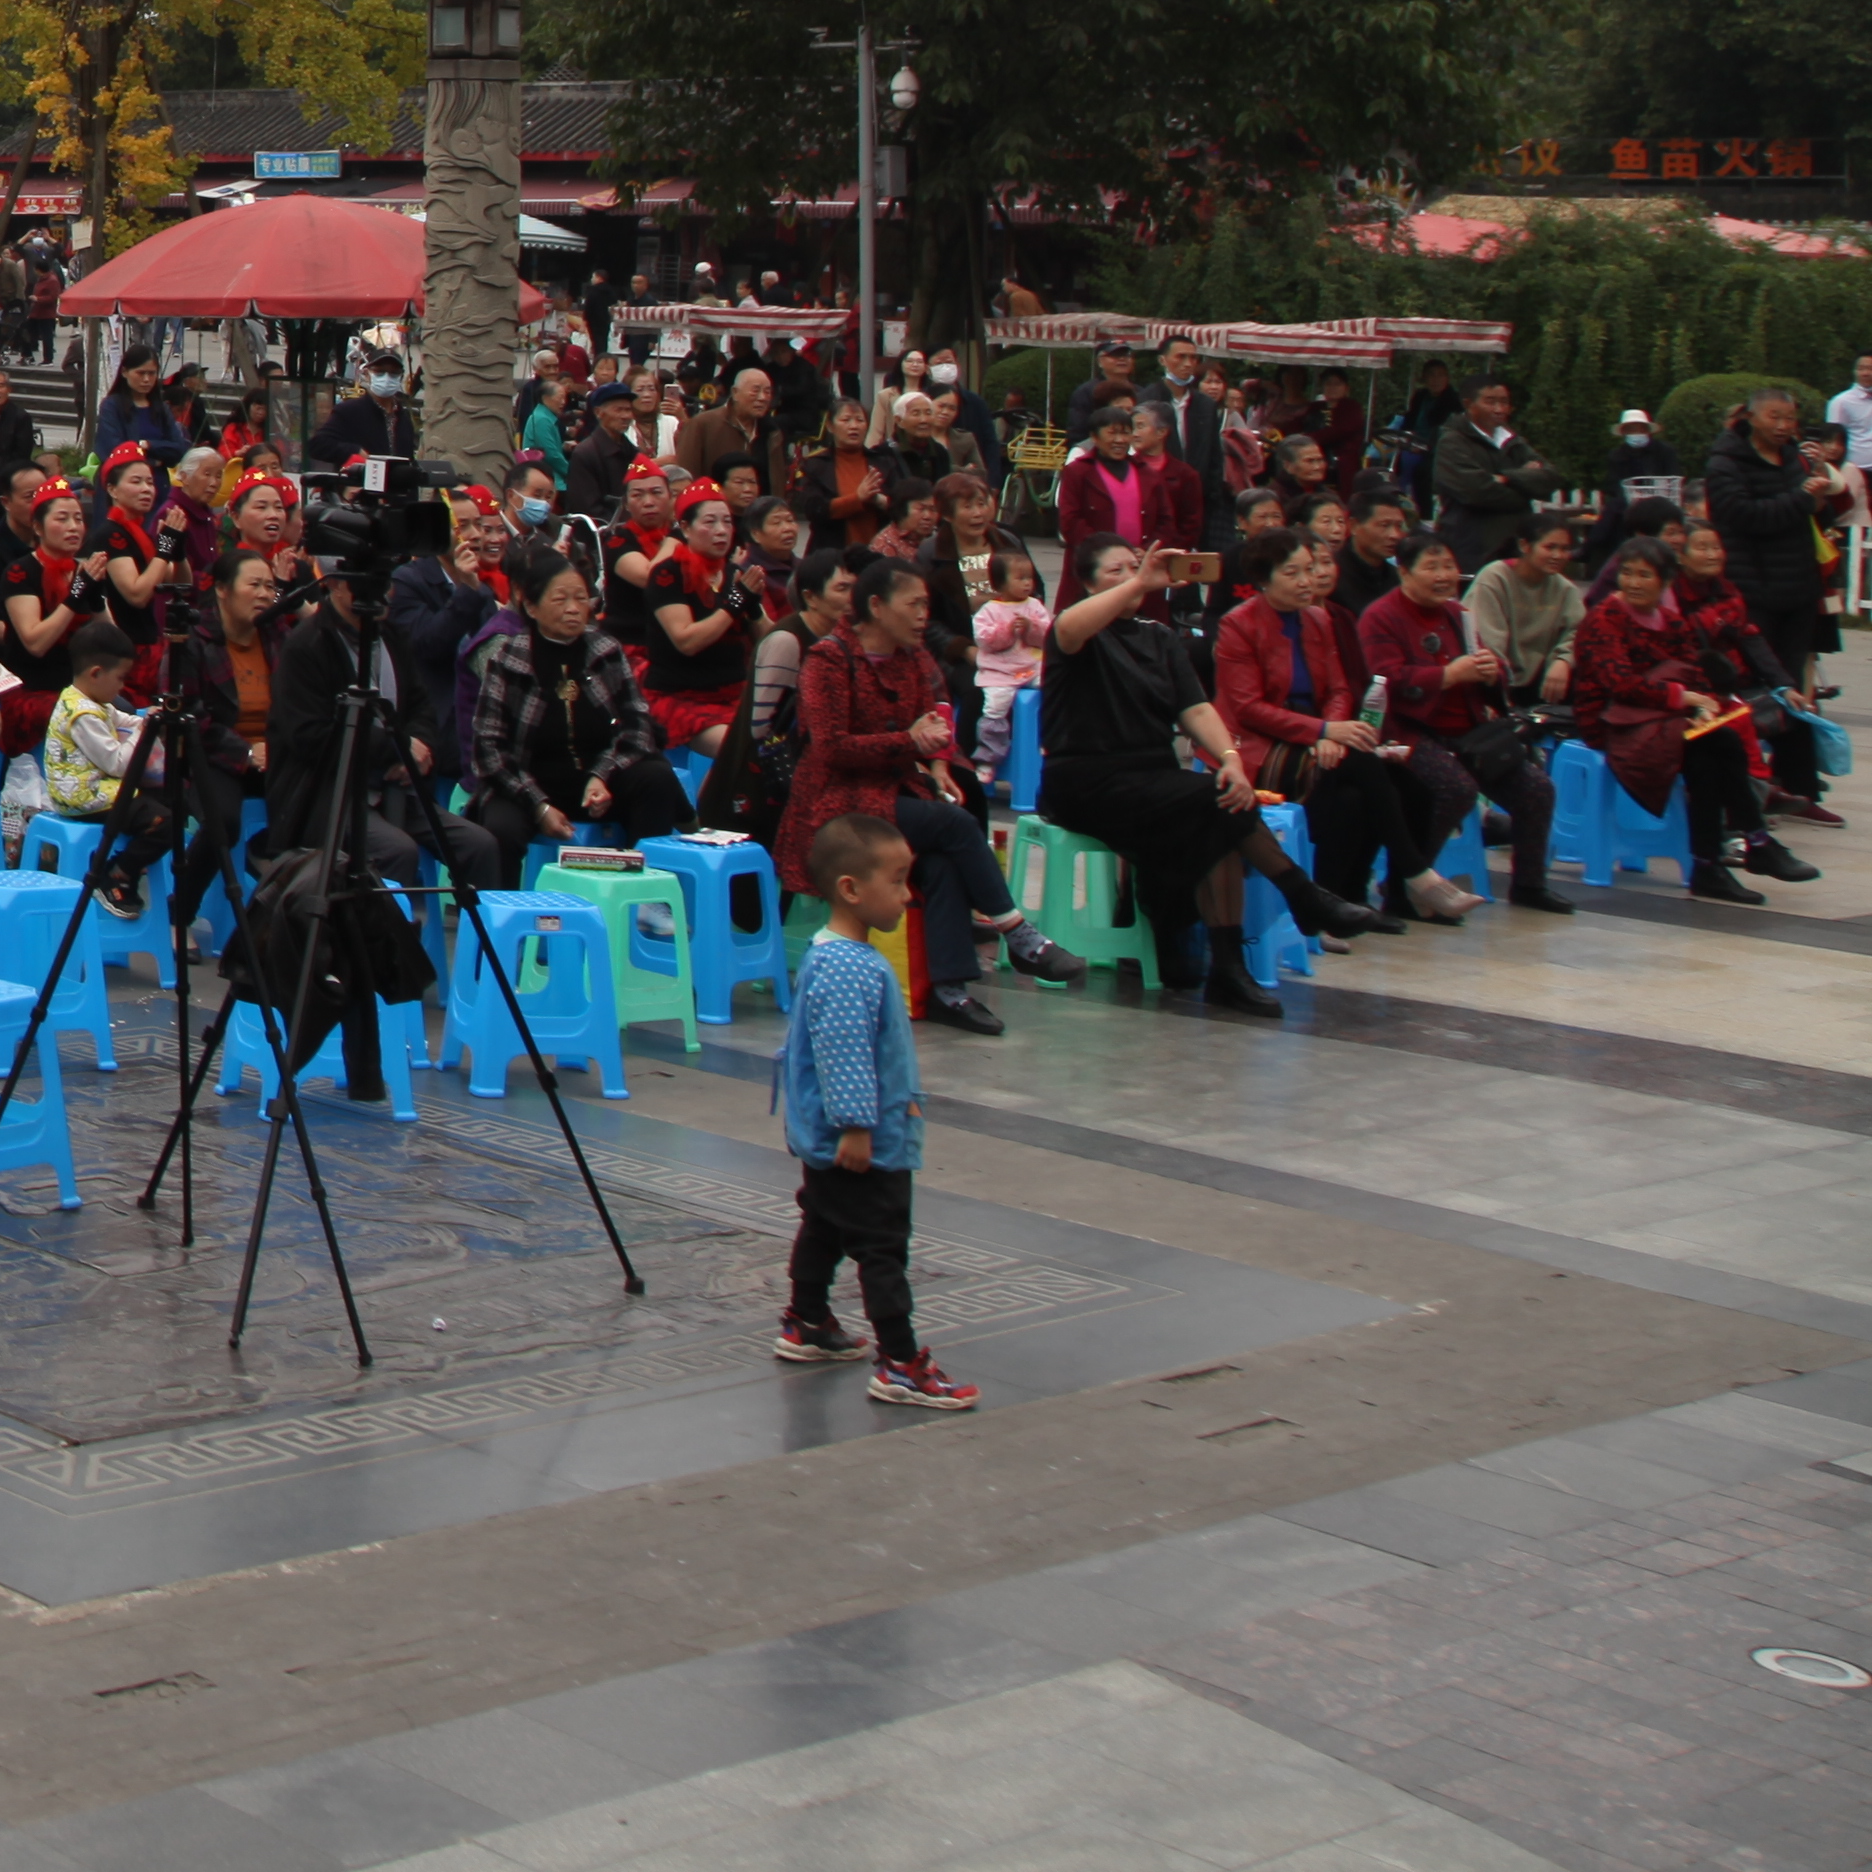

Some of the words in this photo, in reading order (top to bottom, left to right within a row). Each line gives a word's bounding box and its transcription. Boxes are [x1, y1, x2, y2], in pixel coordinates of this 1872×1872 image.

[259, 157, 310, 173] 专业贴膜
[1608, 137, 1813, 179] 鱼苗火锅
